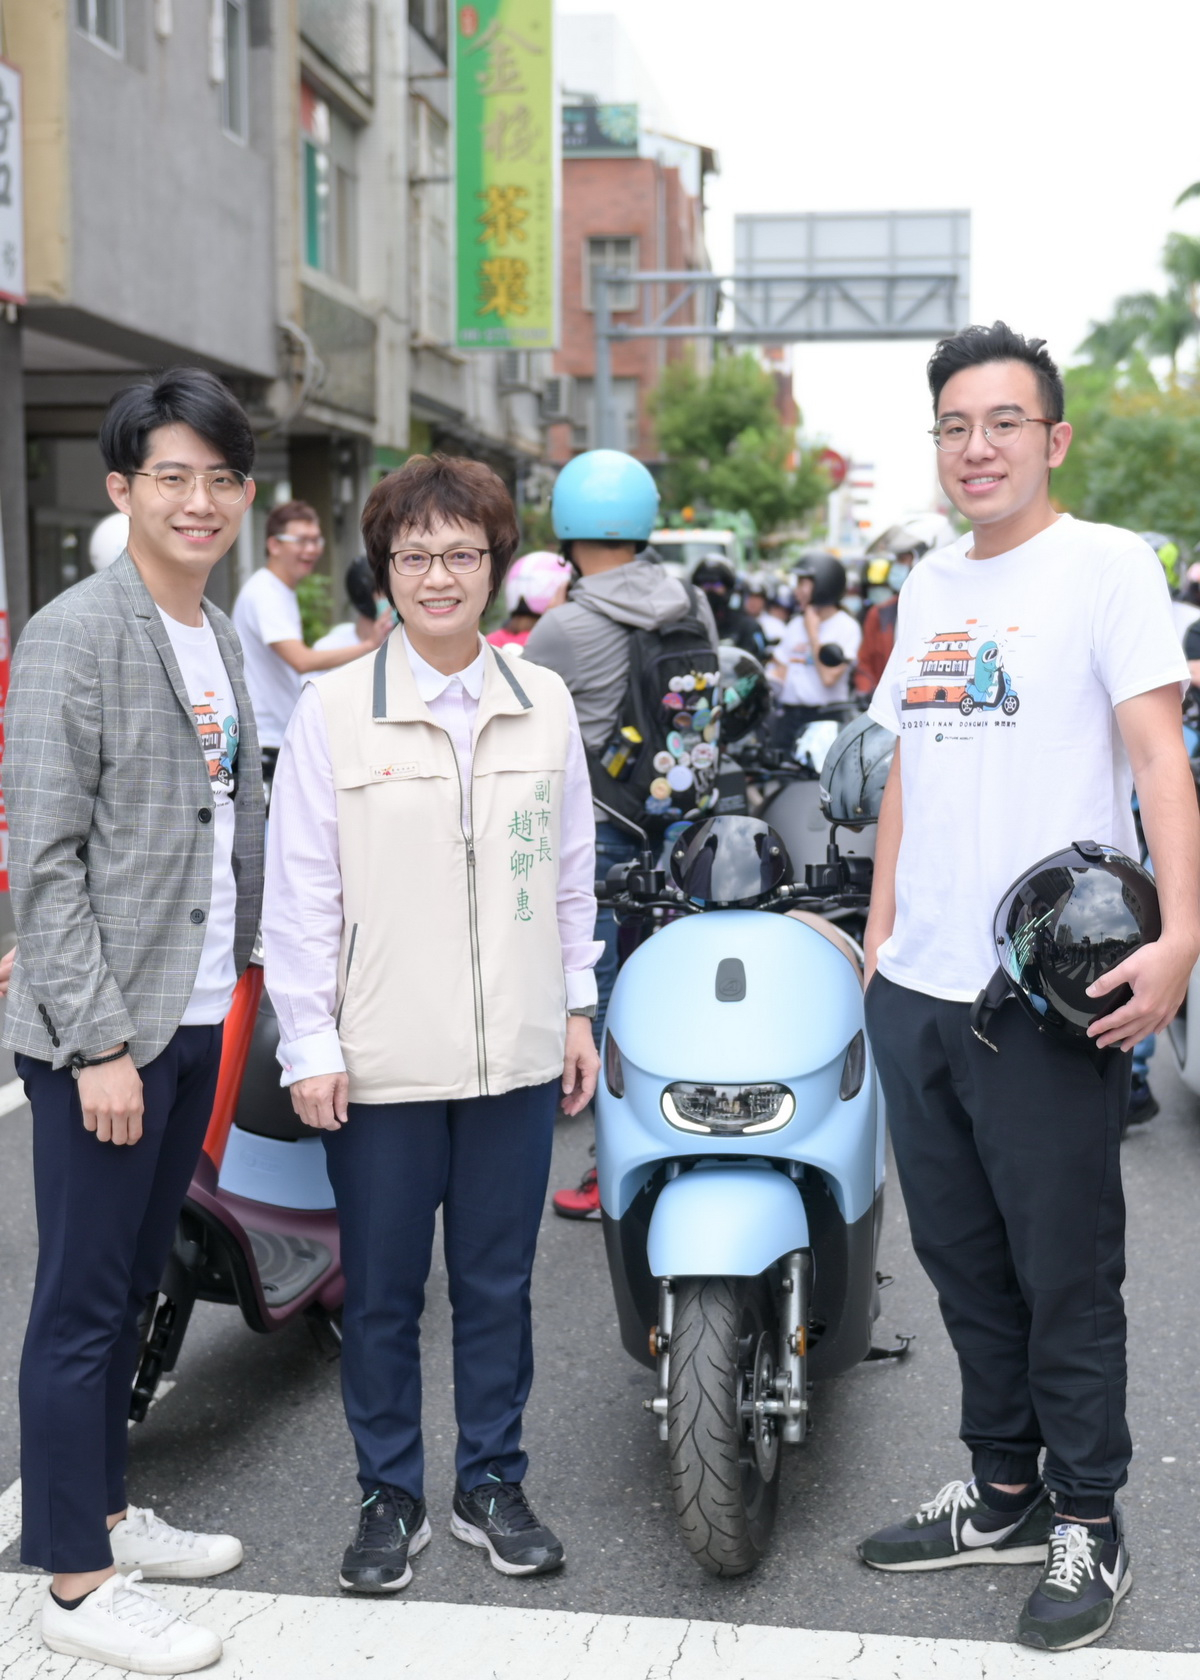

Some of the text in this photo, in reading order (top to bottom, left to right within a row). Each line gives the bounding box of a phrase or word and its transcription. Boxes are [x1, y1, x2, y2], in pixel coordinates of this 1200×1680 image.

[902, 720, 923, 730] 2020
[534, 779, 552, 862] 副市長
[507, 810, 534, 922] 趙卿惠
